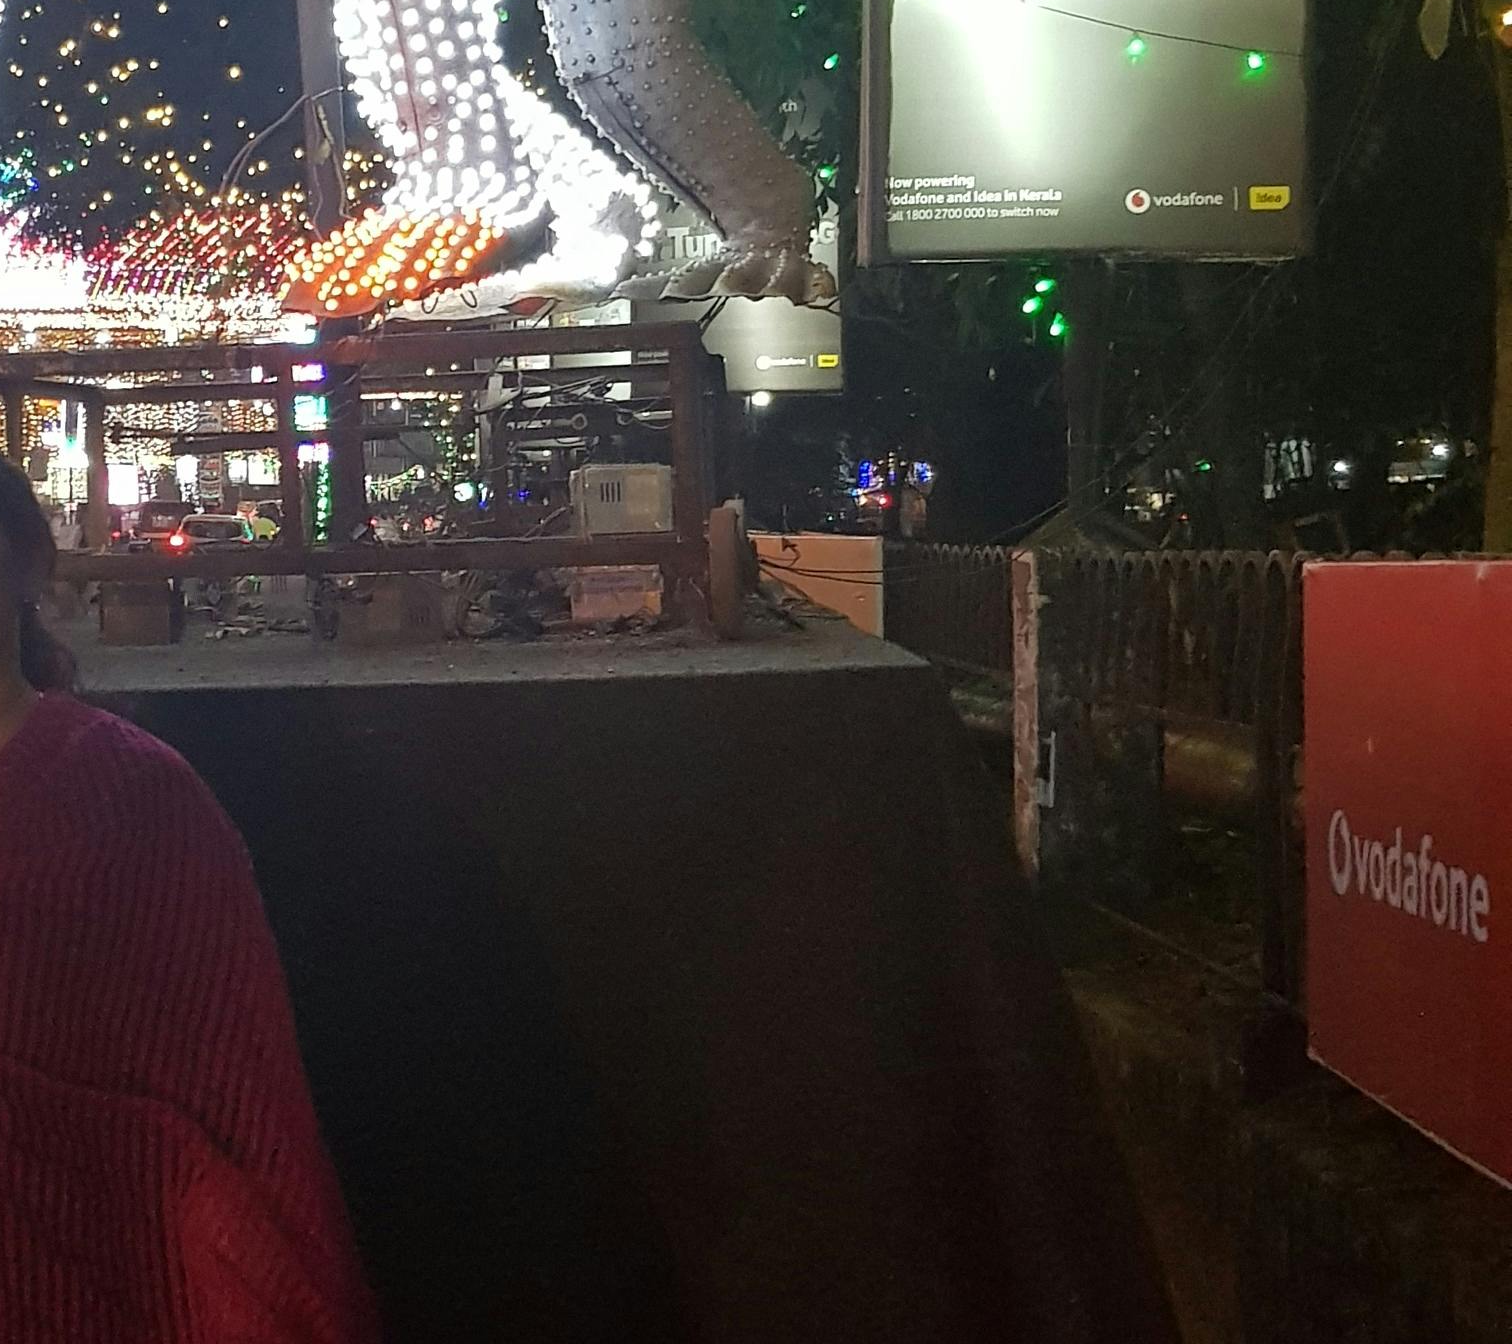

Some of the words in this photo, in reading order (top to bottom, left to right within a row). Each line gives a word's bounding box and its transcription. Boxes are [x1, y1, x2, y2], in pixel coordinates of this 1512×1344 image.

[914, 174, 975, 190] powering
[885, 193, 944, 206] Vodafone
[946, 191, 972, 203] and
[974, 190, 1002, 202] Idea
[1004, 189, 1017, 201] in
[1019, 188, 1063, 201] Kerala
[1153, 192, 1224, 206] vodafone
[906, 209, 933, 220] 1800
[934, 208, 962, 219] 2700
[964, 208, 985, 218] 000
[987, 207, 998, 218] to
[1000, 206, 1034, 218] switch
[1036, 208, 1059, 216] now
[1353, 826, 1490, 943] vodafone
